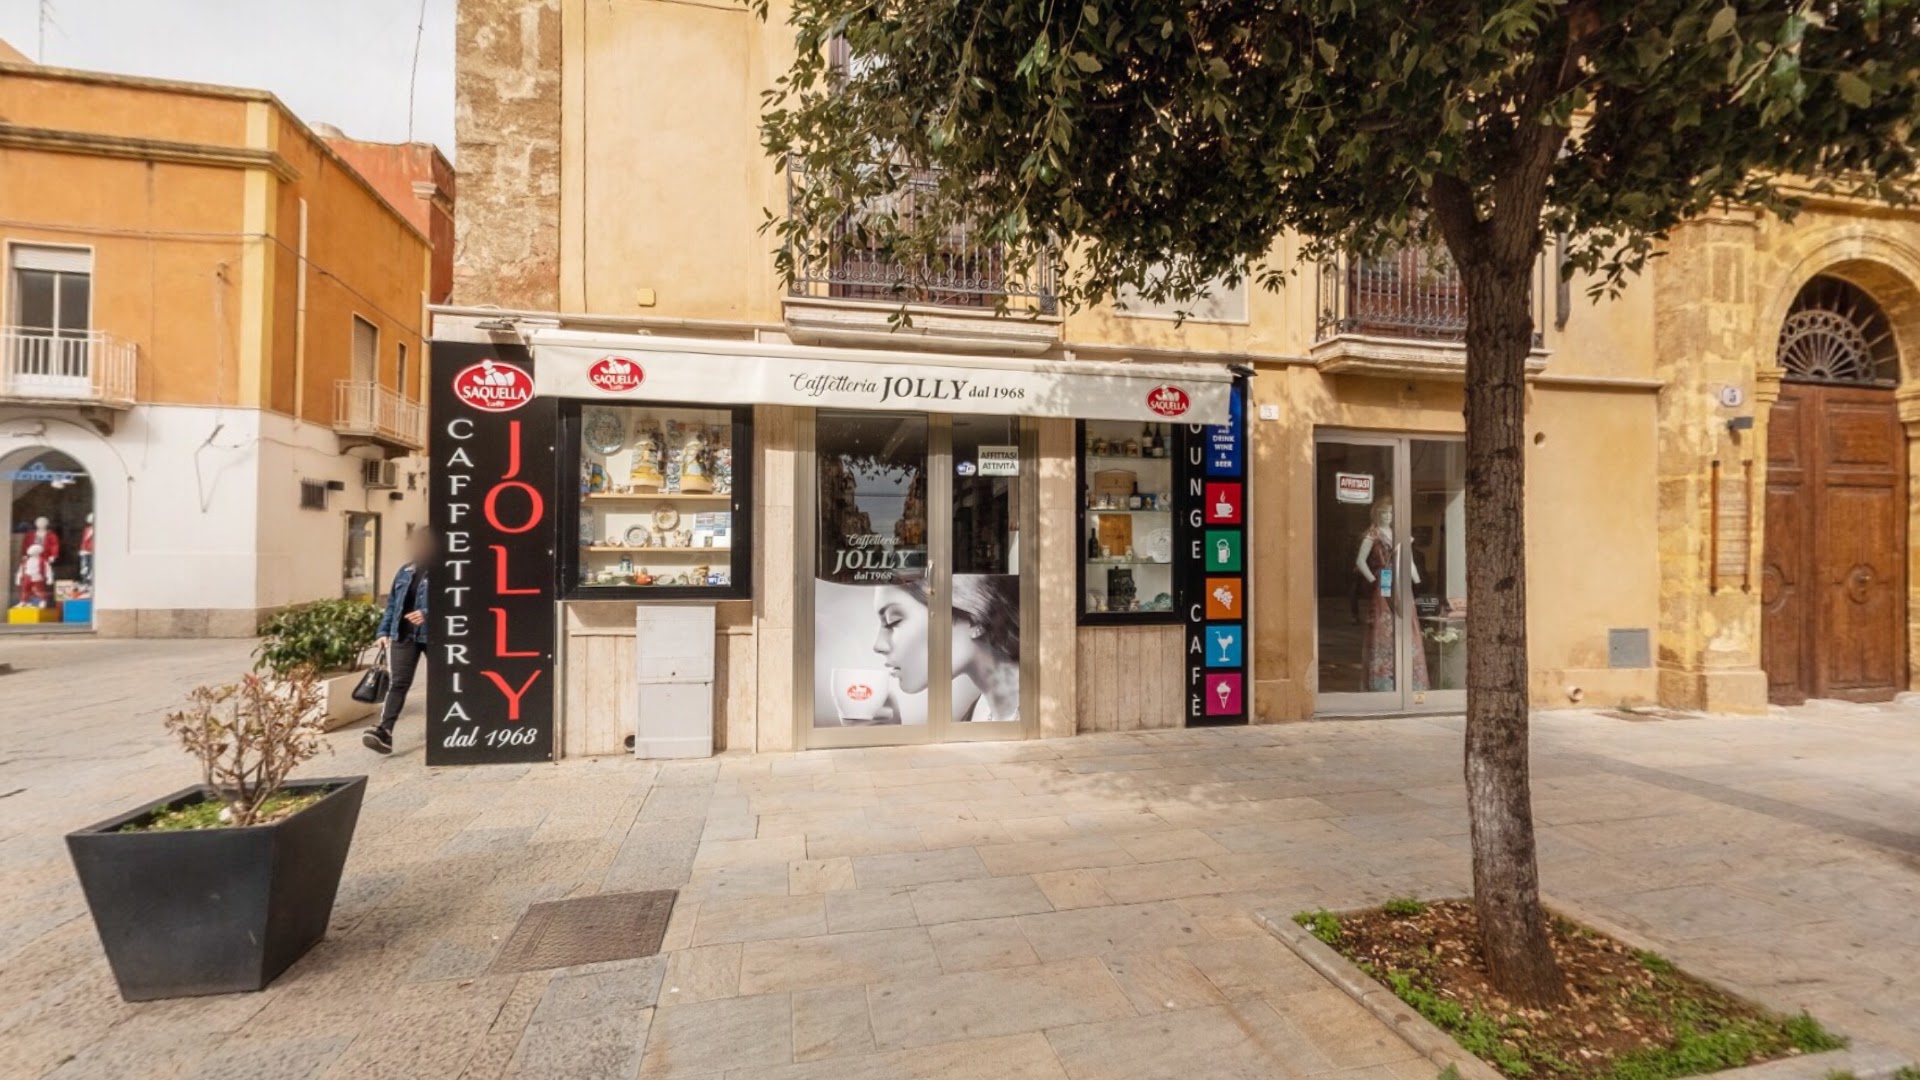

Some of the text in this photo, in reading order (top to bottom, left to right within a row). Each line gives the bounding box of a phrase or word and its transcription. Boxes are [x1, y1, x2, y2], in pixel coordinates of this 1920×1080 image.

[593, 374, 639, 387] SAQUELLA
[463, 385, 527, 402] SAQUELLA
[880, 376, 968, 403] JOLLY
[968, 386, 989, 398] dal
[993, 387, 1025, 399] 1968
[1150, 400, 1187, 411] SAQUELLA
[1214, 443, 1233, 451] WINE
[981, 451, 1017, 460] AFFITTASI
[982, 461, 1016, 470] ATTIVITÀ
[1215, 460, 1232, 468] BEER
[846, 533, 900, 549] Caffetteria
[442, 418, 475, 722] CAFFETTERIA
[480, 420, 544, 720] JOLLY
[832, 549, 914, 575] JOLLY
[1190, 423, 1202, 716] OUNGE CAFÈ
[854, 571, 892, 580] dal 1968
[442, 726, 538, 748] dal 1968
